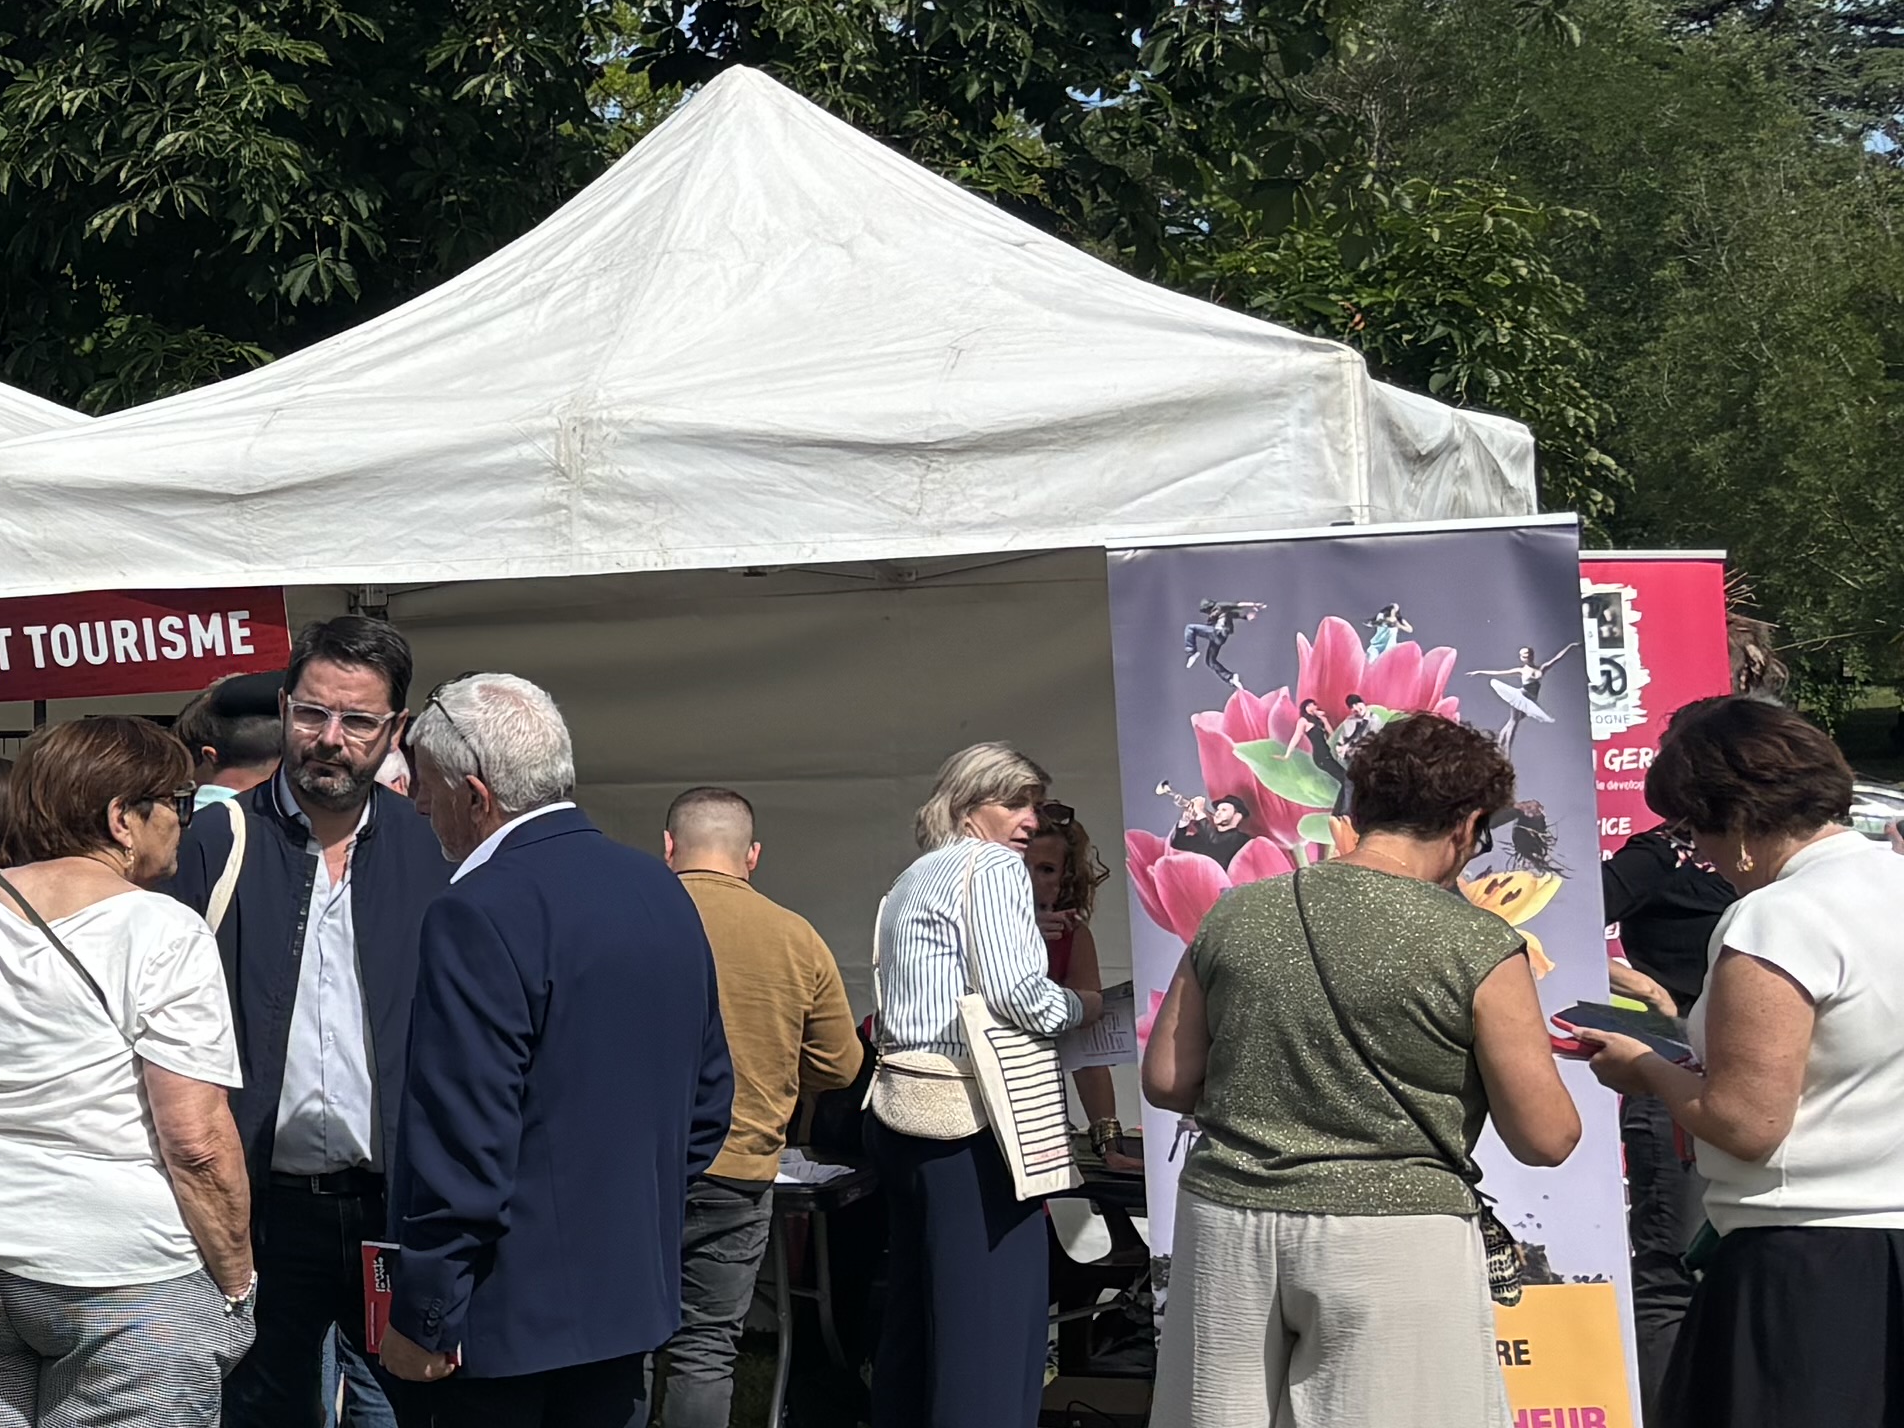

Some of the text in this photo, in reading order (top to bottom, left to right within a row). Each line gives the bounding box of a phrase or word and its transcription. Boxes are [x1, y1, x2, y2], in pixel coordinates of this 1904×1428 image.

[23, 610, 256, 666] TOURISME
[1595, 714, 1631, 725] OGNE
[1597, 817, 1632, 836] ICE
[1496, 1339, 1532, 1366] RE
